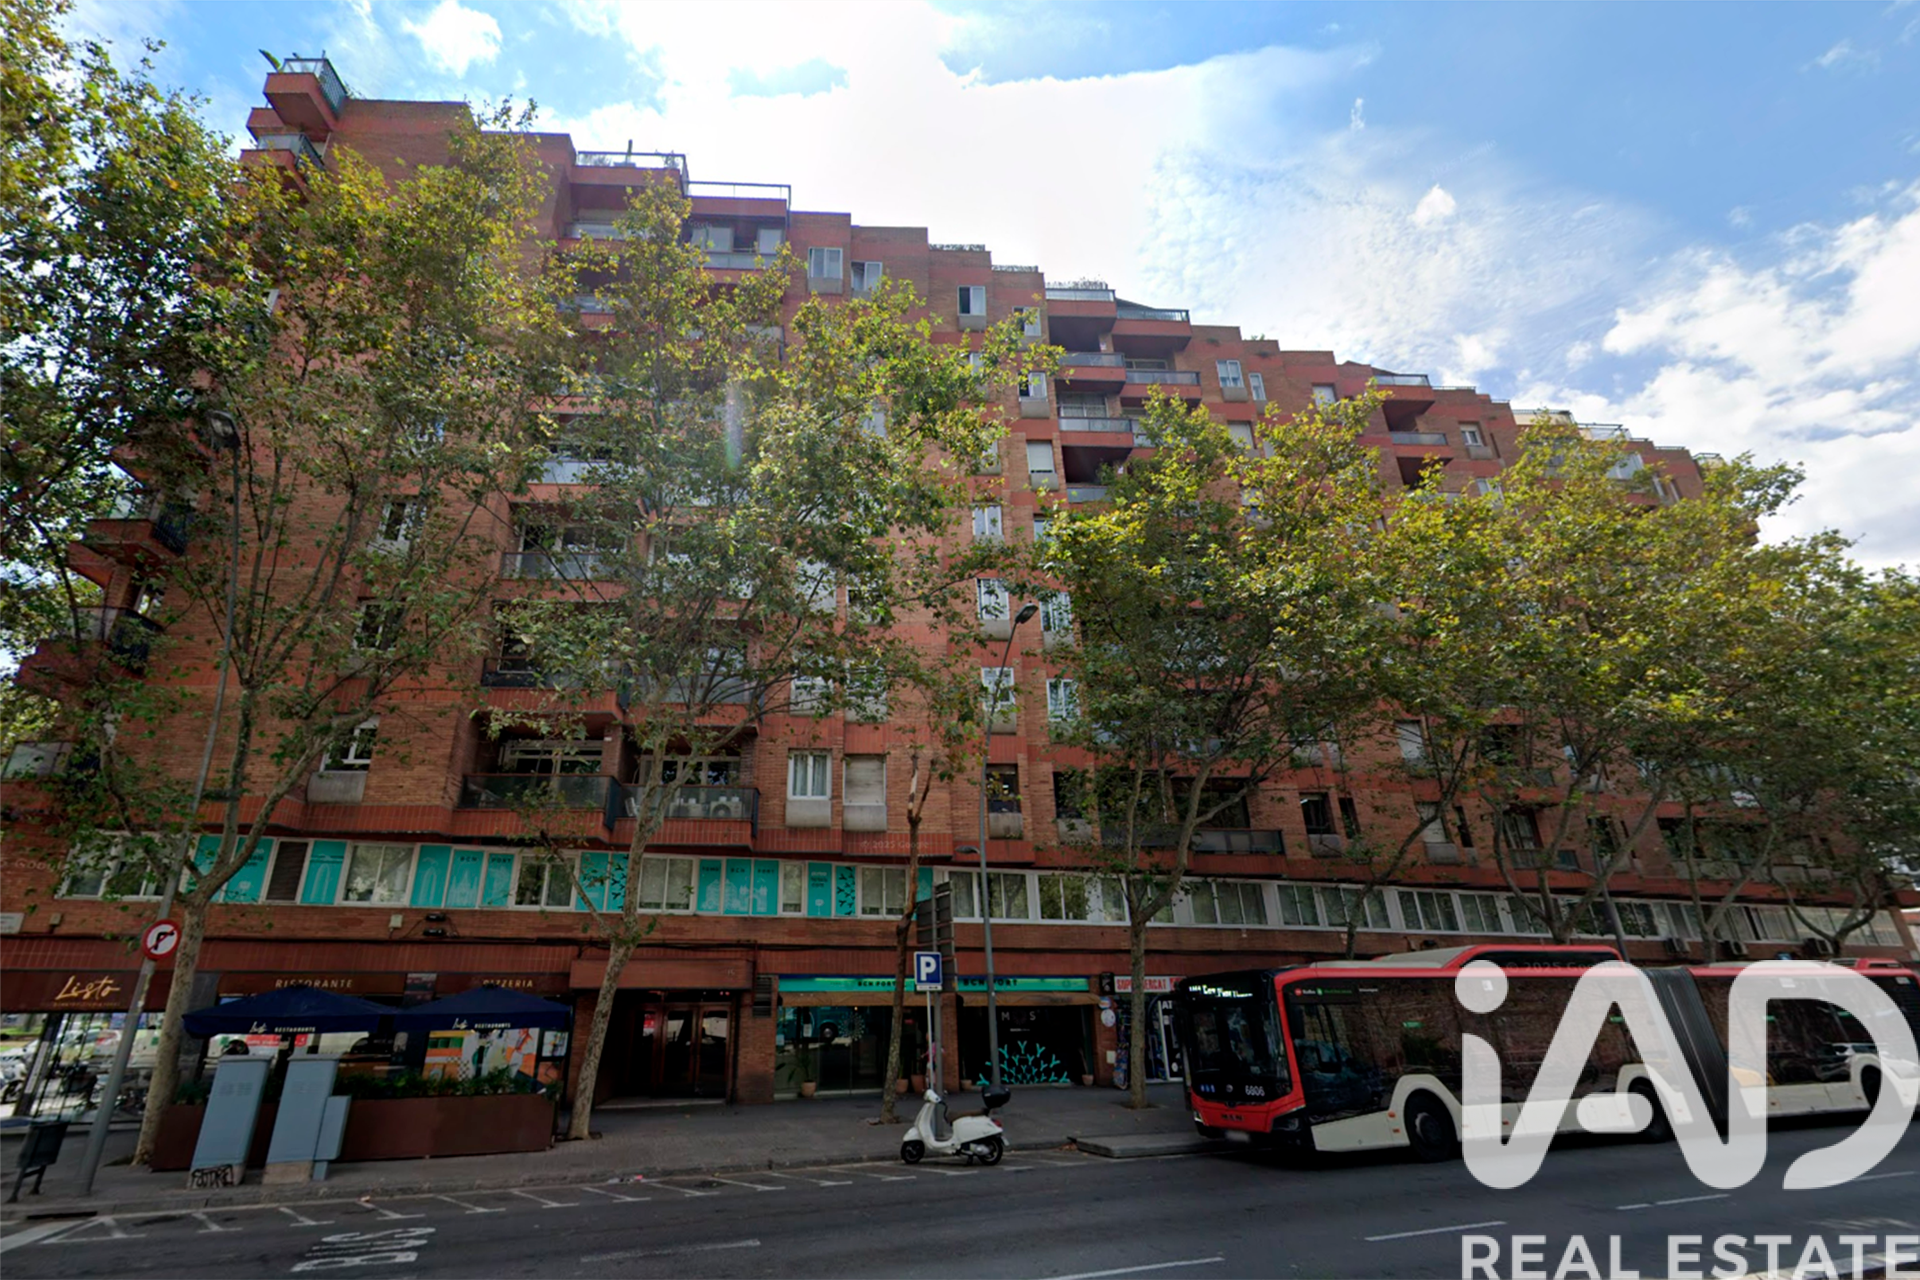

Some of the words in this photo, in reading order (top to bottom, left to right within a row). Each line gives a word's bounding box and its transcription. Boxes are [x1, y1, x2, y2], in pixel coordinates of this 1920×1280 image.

[920, 956, 937, 981] P
[55, 975, 121, 1001] Listo
[1117, 979, 1167, 990] SUPERCAT
